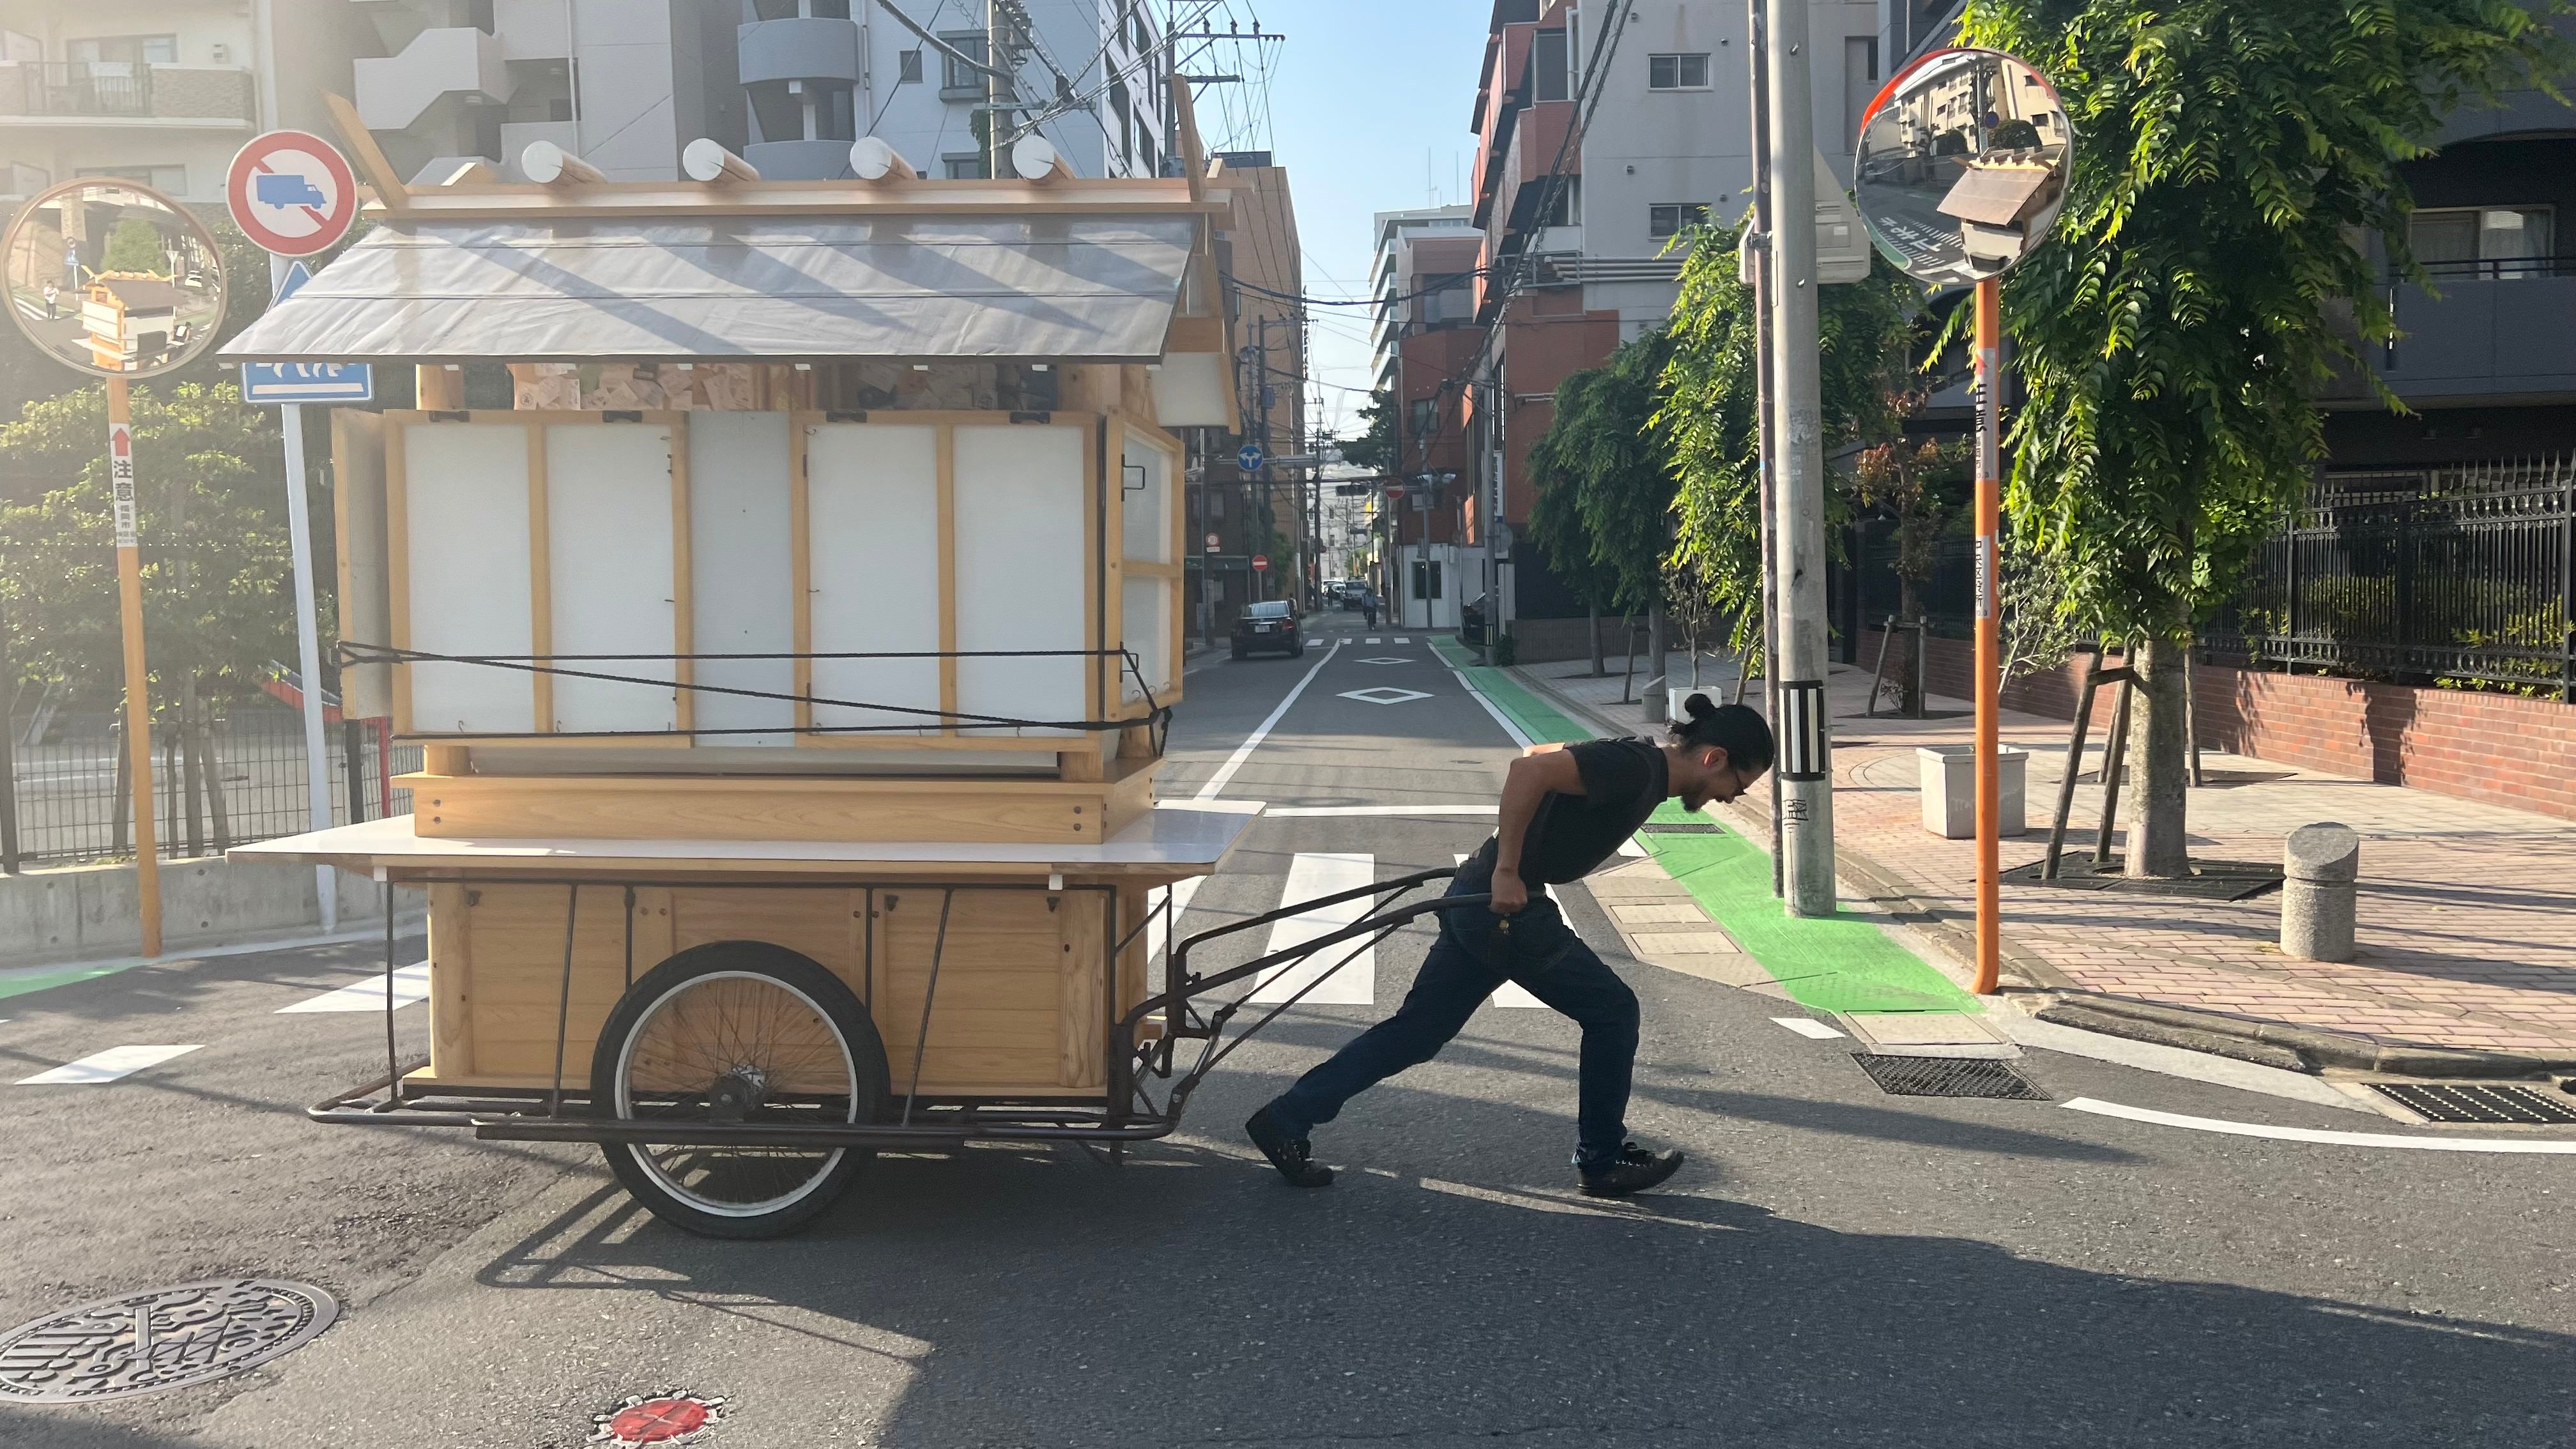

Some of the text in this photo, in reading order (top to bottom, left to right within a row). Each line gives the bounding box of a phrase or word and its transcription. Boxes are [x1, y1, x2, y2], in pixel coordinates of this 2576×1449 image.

[113, 460, 134, 502] 注意
[120, 505, 131, 529] 福岡市
